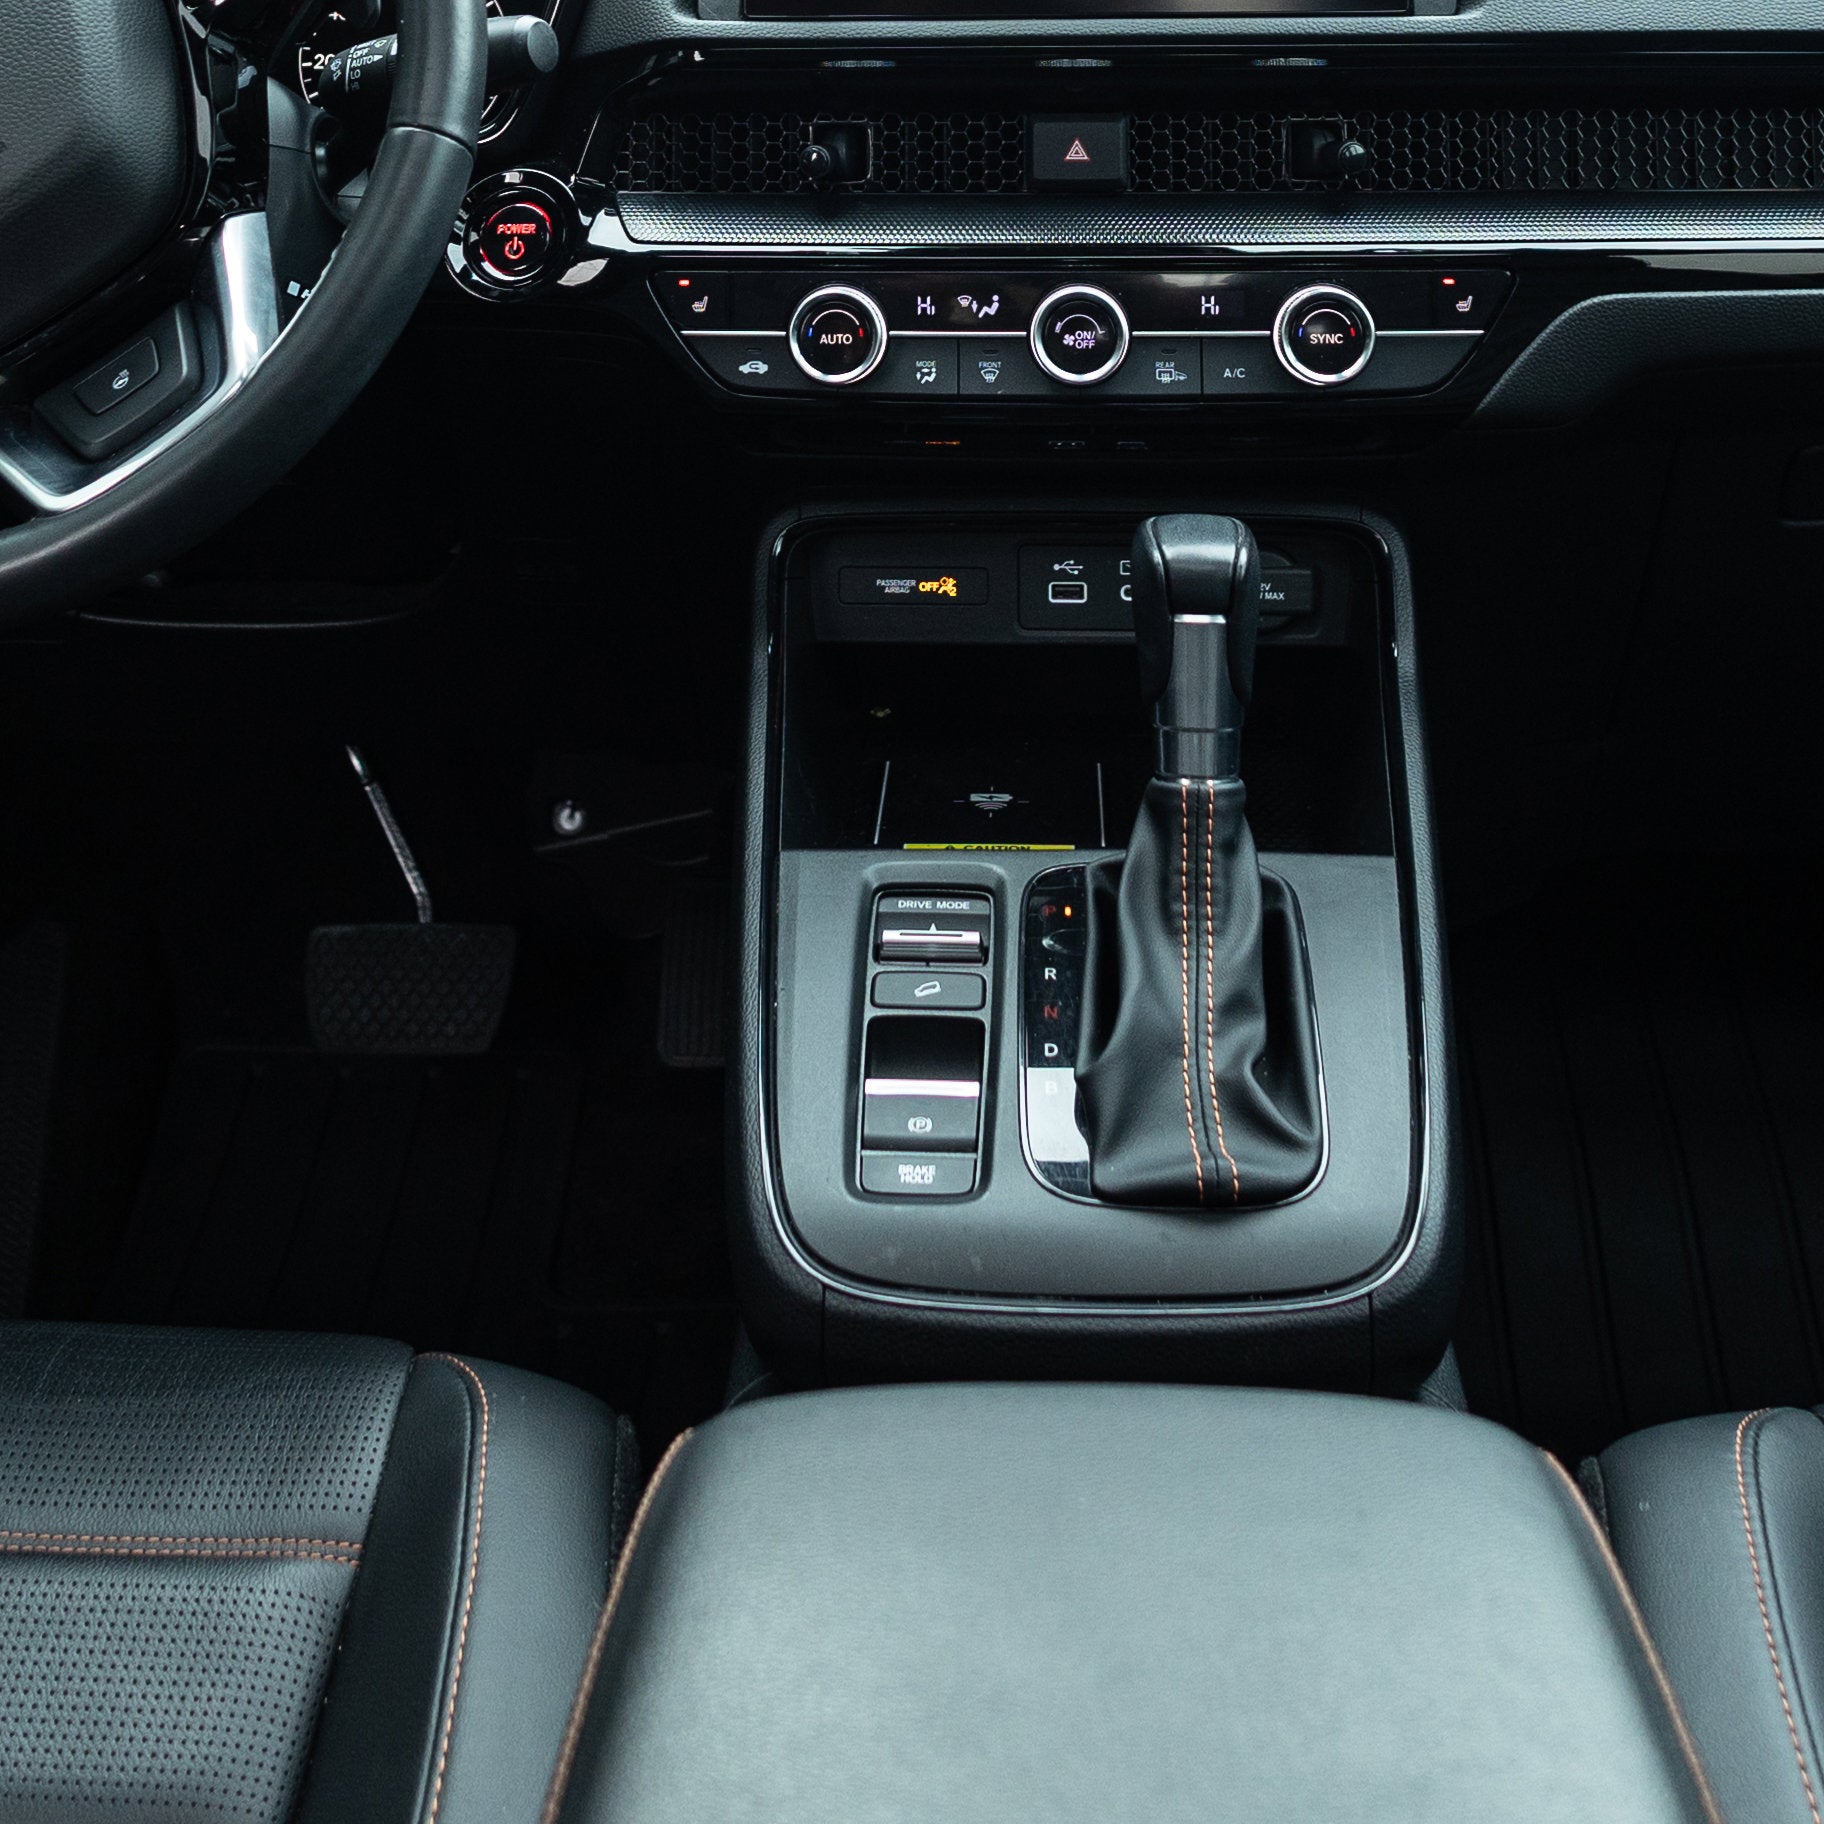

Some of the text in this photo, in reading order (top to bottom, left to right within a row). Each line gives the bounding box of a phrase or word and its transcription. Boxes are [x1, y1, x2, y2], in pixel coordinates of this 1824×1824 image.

[352, 47, 371, 59] OFF
[351, 54, 374, 68] AUTO
[350, 68, 362, 80] LO
[496, 223, 537, 235] POWER
[819, 333, 853, 345] AUTO
[1075, 330, 1096, 340] ON/
[1309, 333, 1344, 345] SYNC
[1075, 339, 1096, 350] OFF
[915, 360, 937, 368] MODE
[1155, 361, 1175, 369] REAR
[1223, 368, 1246, 379] A/C
[876, 578, 917, 587] PASSENGER
[918, 581, 940, 592] OFF
[884, 586, 911, 594] AIRBAG
[1264, 592, 1285, 601] MAX
[897, 900, 970, 909] DRIVE MODE
[1042, 905, 1057, 917] P
[1044, 967, 1057, 980] R
[1044, 1005, 1059, 1020] N
[1044, 1042, 1059, 1058] D
[1044, 1081, 1058, 1095] B
[897, 1164, 937, 1177] BRAKE
[900, 1175, 934, 1184] HOLD
